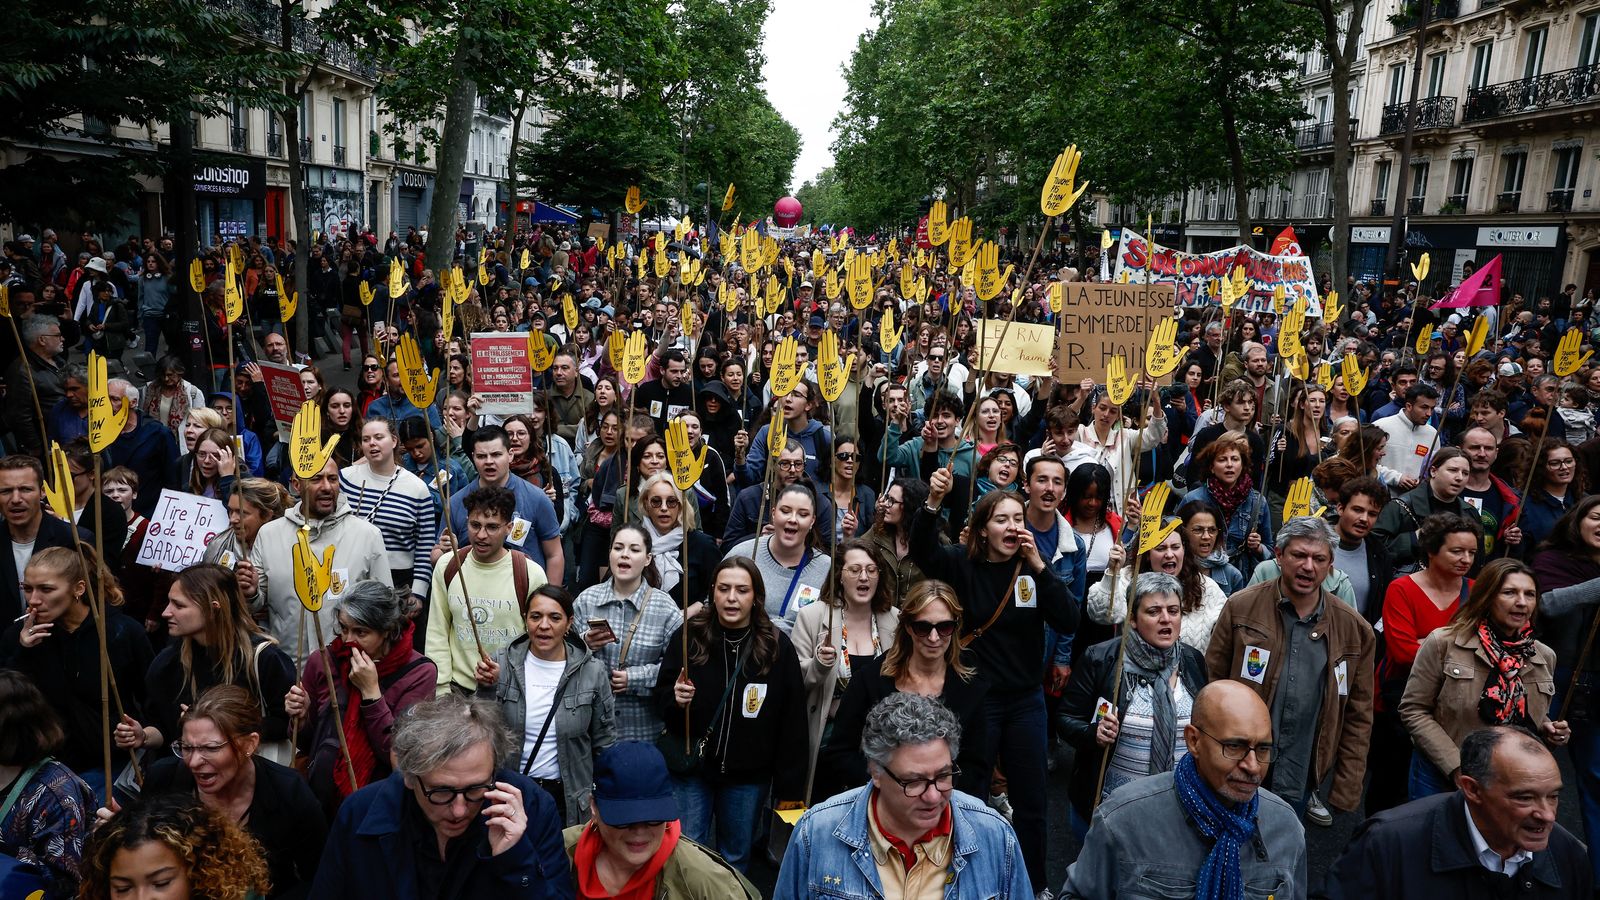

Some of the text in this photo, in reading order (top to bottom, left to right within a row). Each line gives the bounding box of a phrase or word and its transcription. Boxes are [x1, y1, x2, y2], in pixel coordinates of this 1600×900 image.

[404, 172, 427, 188] ODEON
[1067, 287, 1174, 309] LA JEUNESSE
[1064, 314, 1142, 334] EMMERDE
[1016, 326, 1043, 343] RN
[1067, 342, 1091, 370] R.
[299, 436, 317, 445] TOUCHE
[300, 445, 309, 454] PAS
[299, 463, 313, 471] POTE
[163, 496, 213, 527] Tire Toi
[1292, 502, 1307, 510] TOUCHE
[164, 521, 175, 537] de
